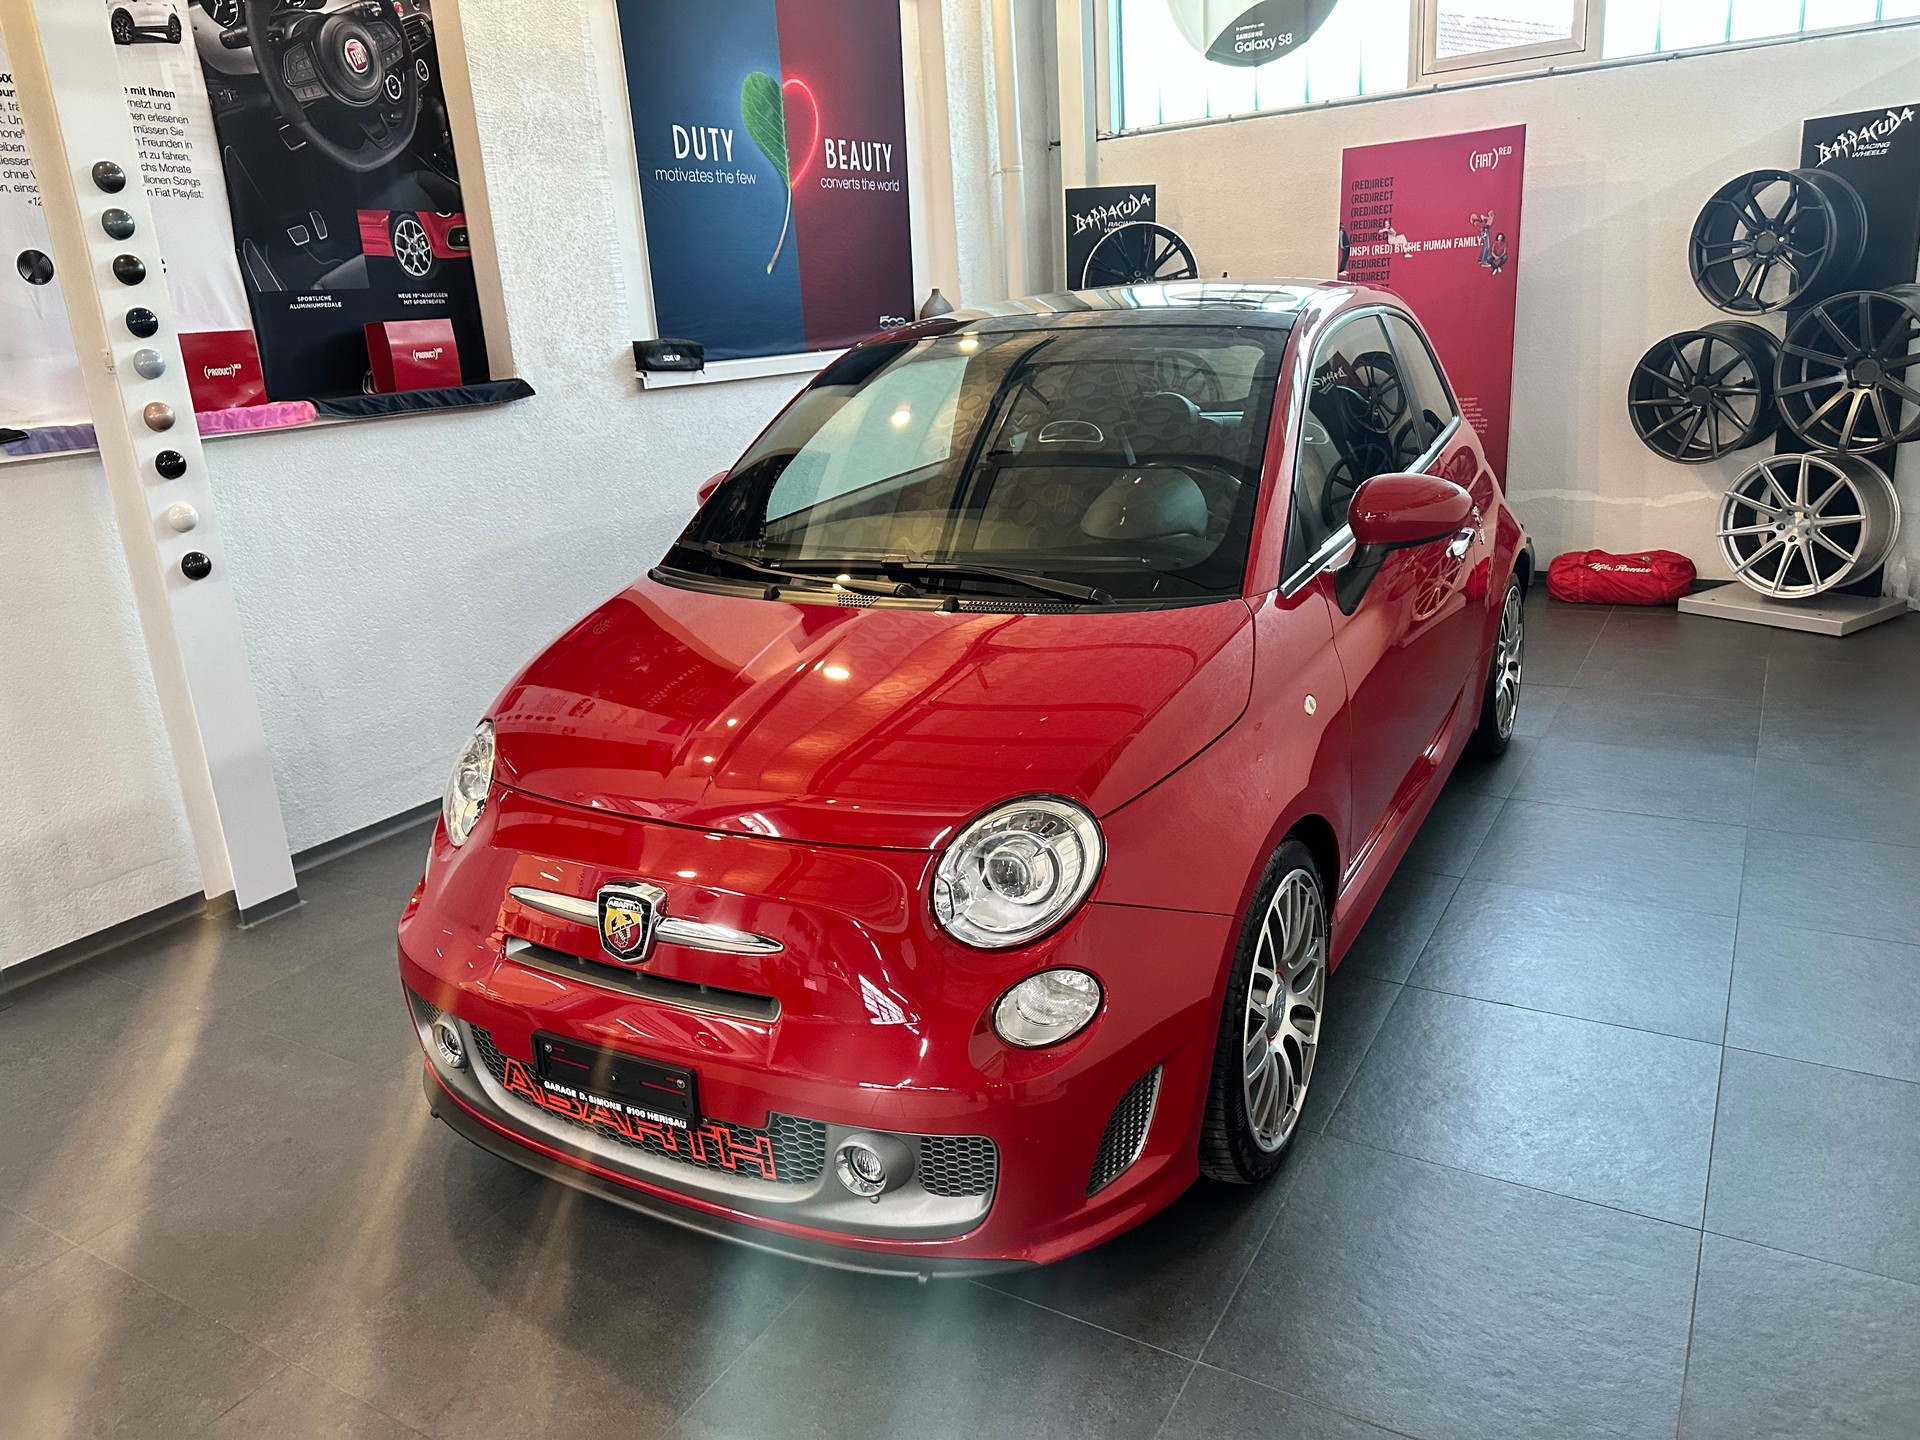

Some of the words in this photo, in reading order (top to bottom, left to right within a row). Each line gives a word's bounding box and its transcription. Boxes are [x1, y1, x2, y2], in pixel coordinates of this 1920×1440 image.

[1235, 37, 1277, 53] Galaxy
[1278, 32, 1292, 46] S8
[130, 86, 147, 96] mit
[148, 87, 176, 98] Ihnen
[154, 101, 171, 110] und
[148, 114, 189, 124] erlesenen
[133, 124, 168, 135] müssen
[170, 126, 184, 136] Sie
[142, 137, 183, 148] Freunden
[184, 140, 193, 149] in
[1814, 107, 1915, 168] BARRACUDA
[672, 124, 734, 162] DUTY
[825, 138, 892, 173] BEAUTY
[1857, 142, 1891, 151] RACING
[149, 152, 160, 160] zu
[162, 151, 192, 161] fahren.
[1852, 149, 1887, 158] WHEELS
[3, 170, 29, 179] ohne
[158, 163, 192, 174] Monate
[173, 176, 201, 188] Songs
[655, 168, 714, 184] motivates
[715, 169, 733, 184] the
[734, 170, 756, 185] few
[820, 177, 860, 191] converts
[861, 178, 876, 190] the
[876, 178, 900, 192] world
[1352, 176, 1394, 191] (RED)IRECT
[154, 188, 171, 198] Fiat
[172, 188, 204, 200] Playlist:
[1351, 190, 1393, 205] (RED)IRECT
[1072, 193, 1151, 236] BARRACUDA
[1351, 204, 1393, 218] (RED)IRECT
[1349, 246, 1370, 257] INSPI
[1371, 244, 1392, 256] (RED)
[1423, 239, 1451, 251] HUMAN
[1454, 236, 1484, 248] FAMILY.
[1614, 564, 1652, 572] Romeo
[608, 900, 640, 911] ABARTH
[544, 1080, 577, 1098] GARAGE
[579, 1092, 588, 1102] D.
[588, 1095, 622, 1112] SIMONE
[647, 1112, 687, 1129] HERISAU
